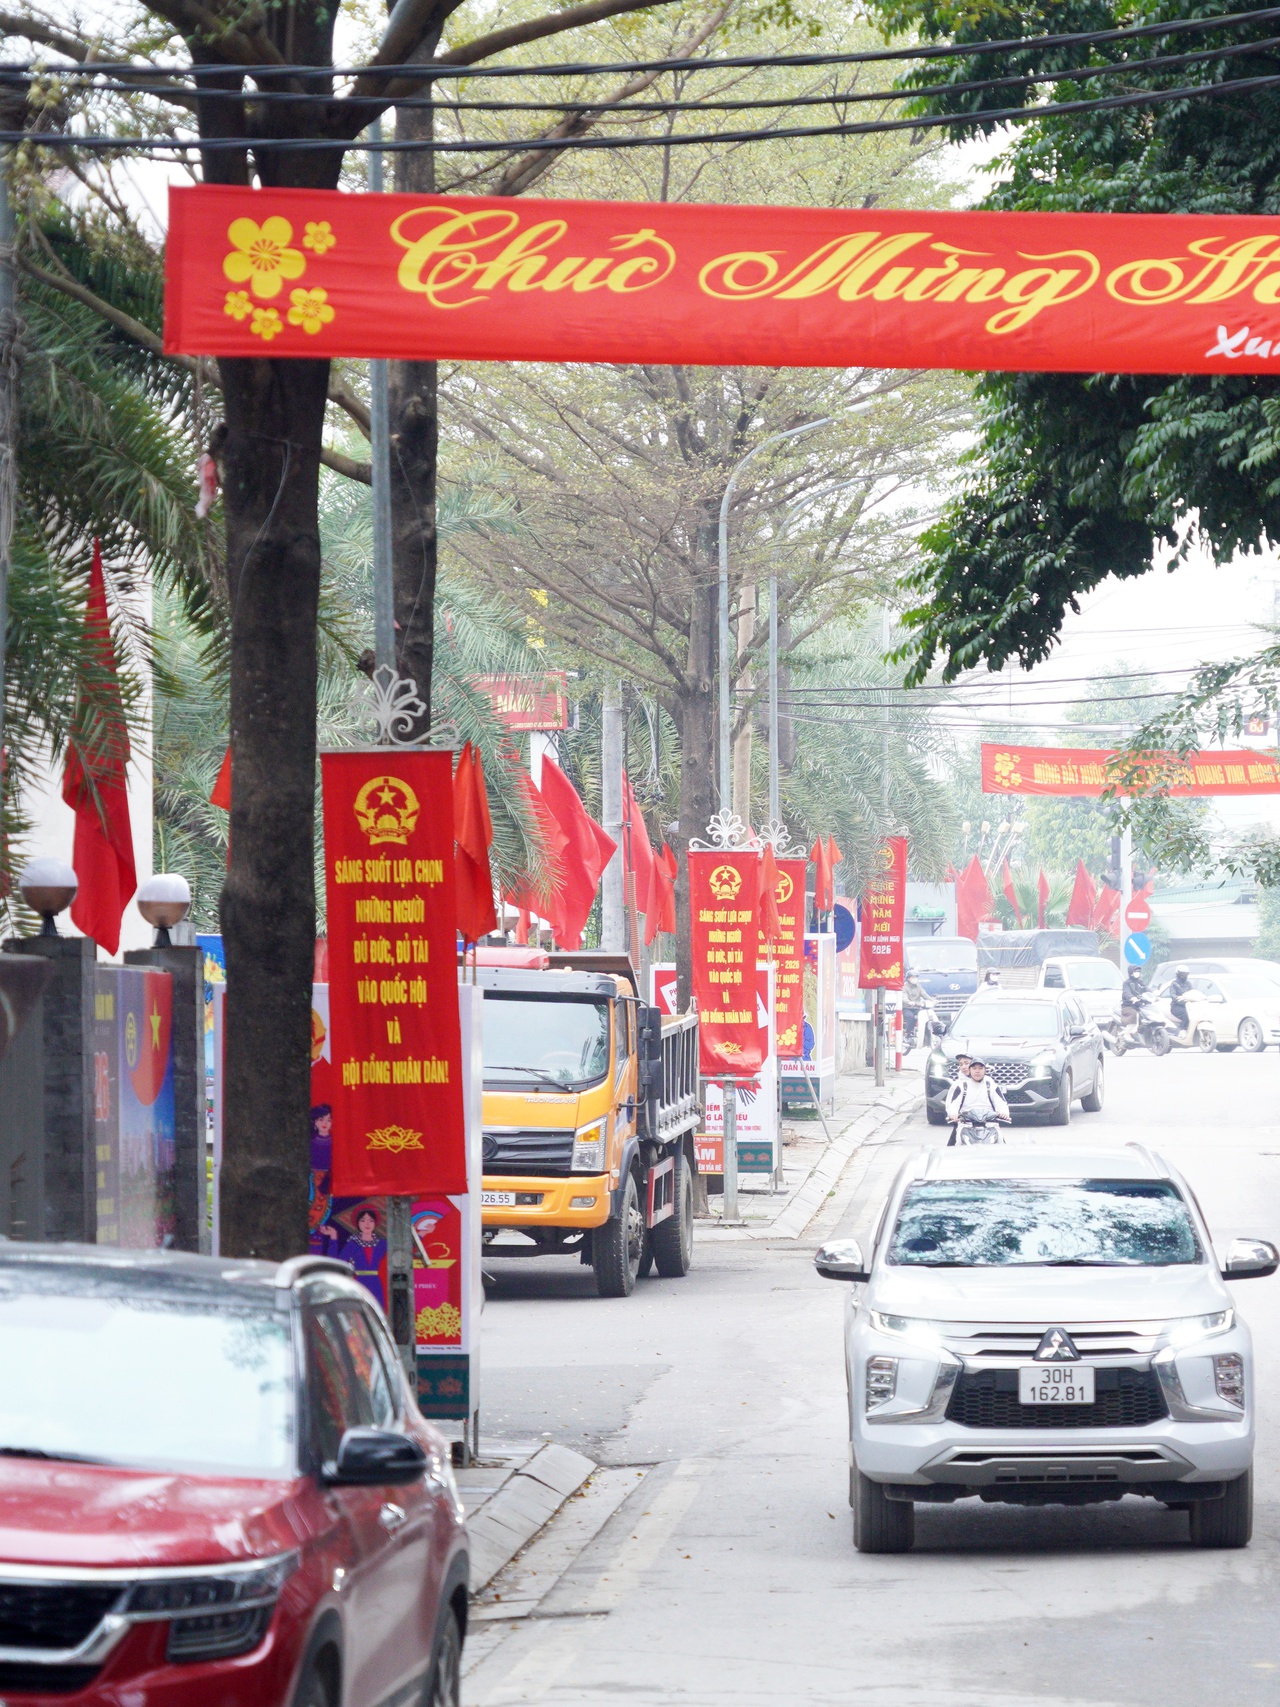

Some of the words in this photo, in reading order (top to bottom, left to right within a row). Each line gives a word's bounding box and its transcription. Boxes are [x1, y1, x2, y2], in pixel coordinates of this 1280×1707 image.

[390, 206, 676, 308] Chúc
[699, 232, 1099, 334] Mừng
[1195, 764, 1225, 786] QUANG
[1225, 764, 1249, 786] VINH,
[335, 855, 363, 884] SÁNG
[365, 852, 391, 883] SUỐT
[393, 857, 413, 888] LỰA
[415, 859, 443, 888] CHỌN
[356, 895, 391, 923] NHỮNG
[393, 894, 424, 923] NGƯỜI
[354, 932, 368, 963] ĐỦ
[370, 935, 395, 966] ĐỨC,
[396, 932, 410, 963] ĐỦ
[412, 935, 429, 963] TÀI
[872, 945, 892, 955] 2026
[358, 975, 378, 1004] VÀO
[380, 972, 408, 1006] QUỐC
[410, 975, 427, 1008] HỘI
[387, 1015, 402, 1045] VÀ
[342, 1057, 360, 1090] HỘI
[362, 1053, 390, 1084] ĐỒNG
[392, 1056, 421, 1084] NHÂN
[423, 1055, 449, 1084] DÂN!
[694, 1143, 716, 1160] ẤM
[1041, 1368, 1073, 1384] 30H
[1030, 1386, 1084, 1401] 162.81
